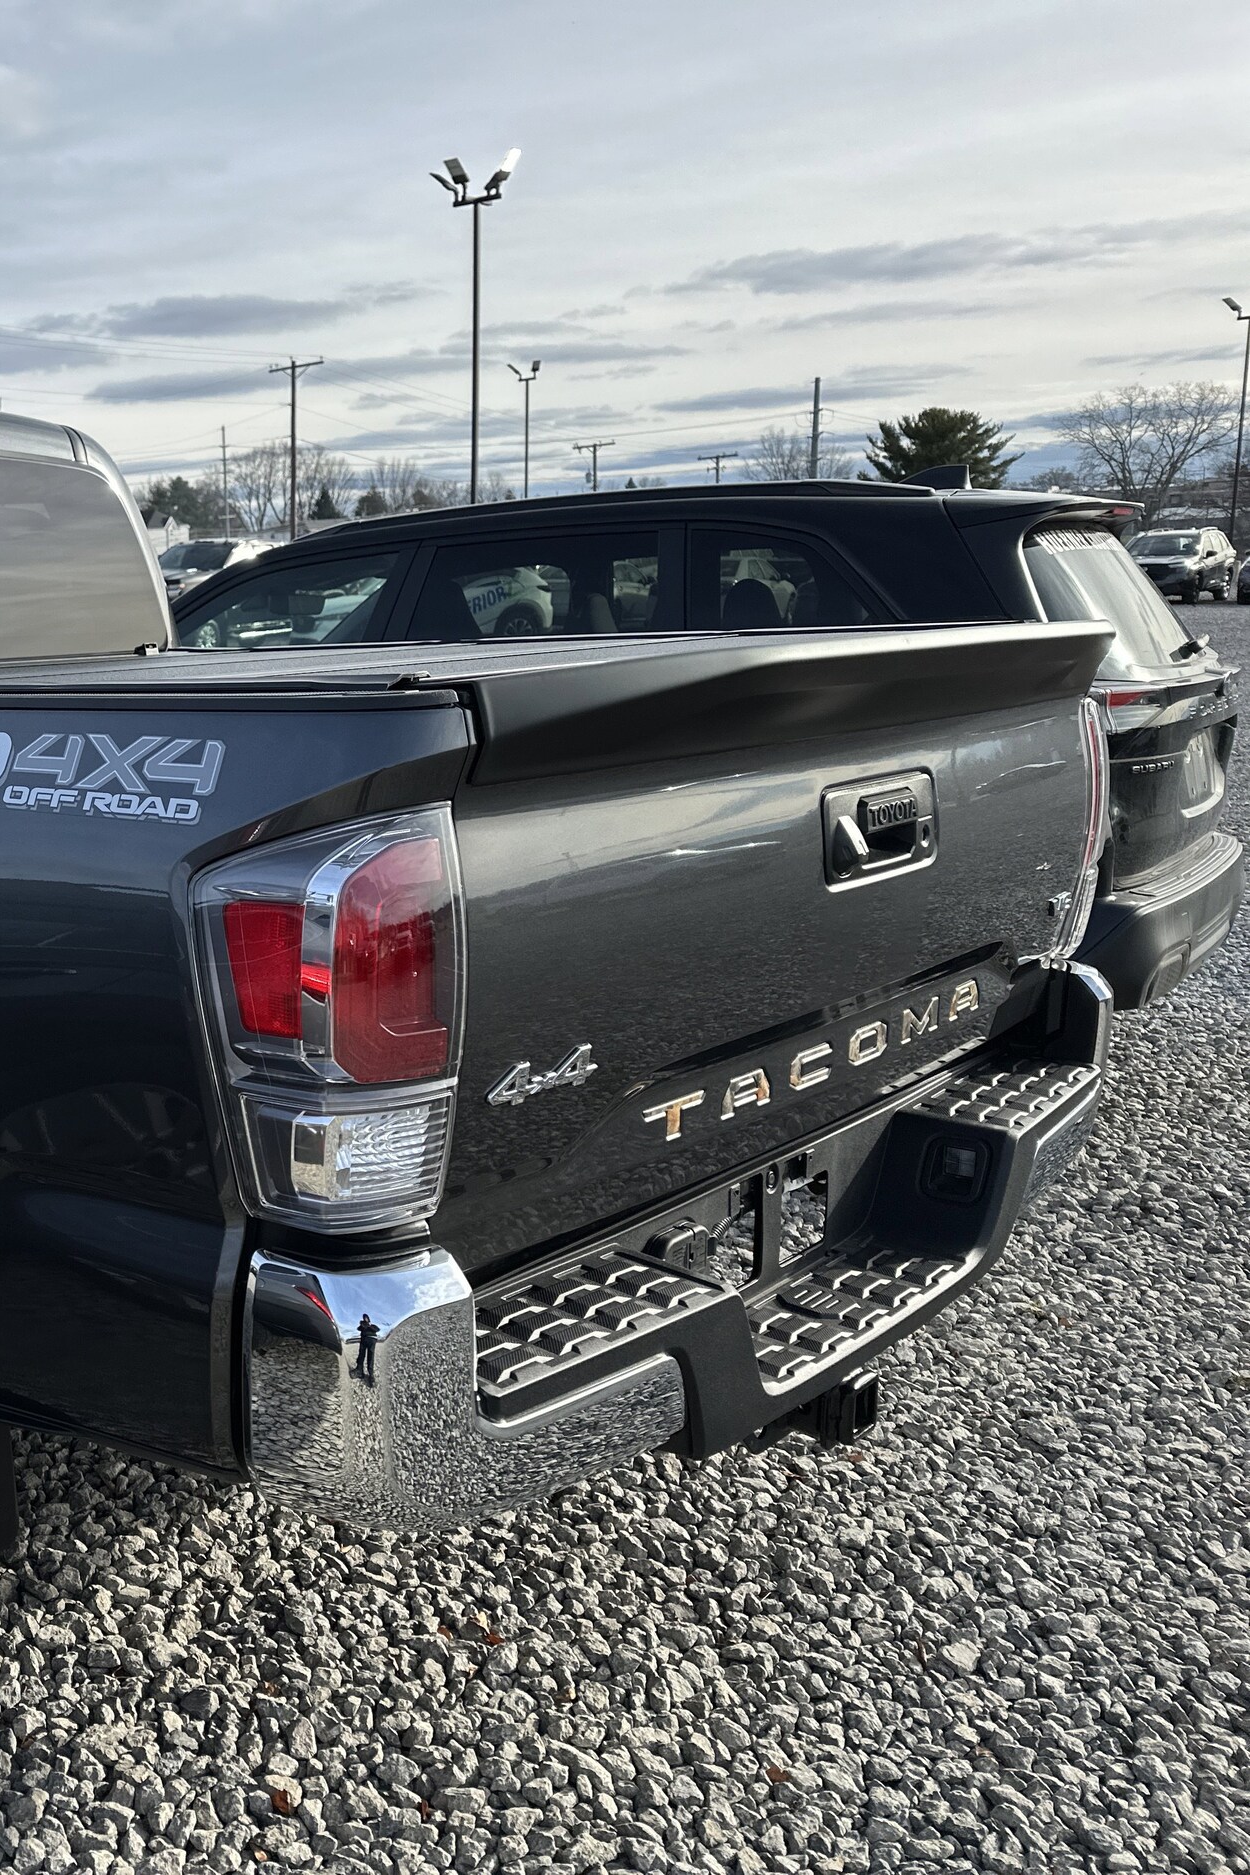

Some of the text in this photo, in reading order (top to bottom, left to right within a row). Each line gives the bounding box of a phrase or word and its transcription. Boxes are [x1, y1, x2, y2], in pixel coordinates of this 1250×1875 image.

[468, 586, 507, 614] RIOR
[11, 733, 227, 796] 4X4
[1131, 760, 1175, 774] SUBARU
[2, 785, 202, 826] OFF ROAD
[868, 797, 918, 828] TOYOTA
[641, 977, 980, 1142] TACOMA
